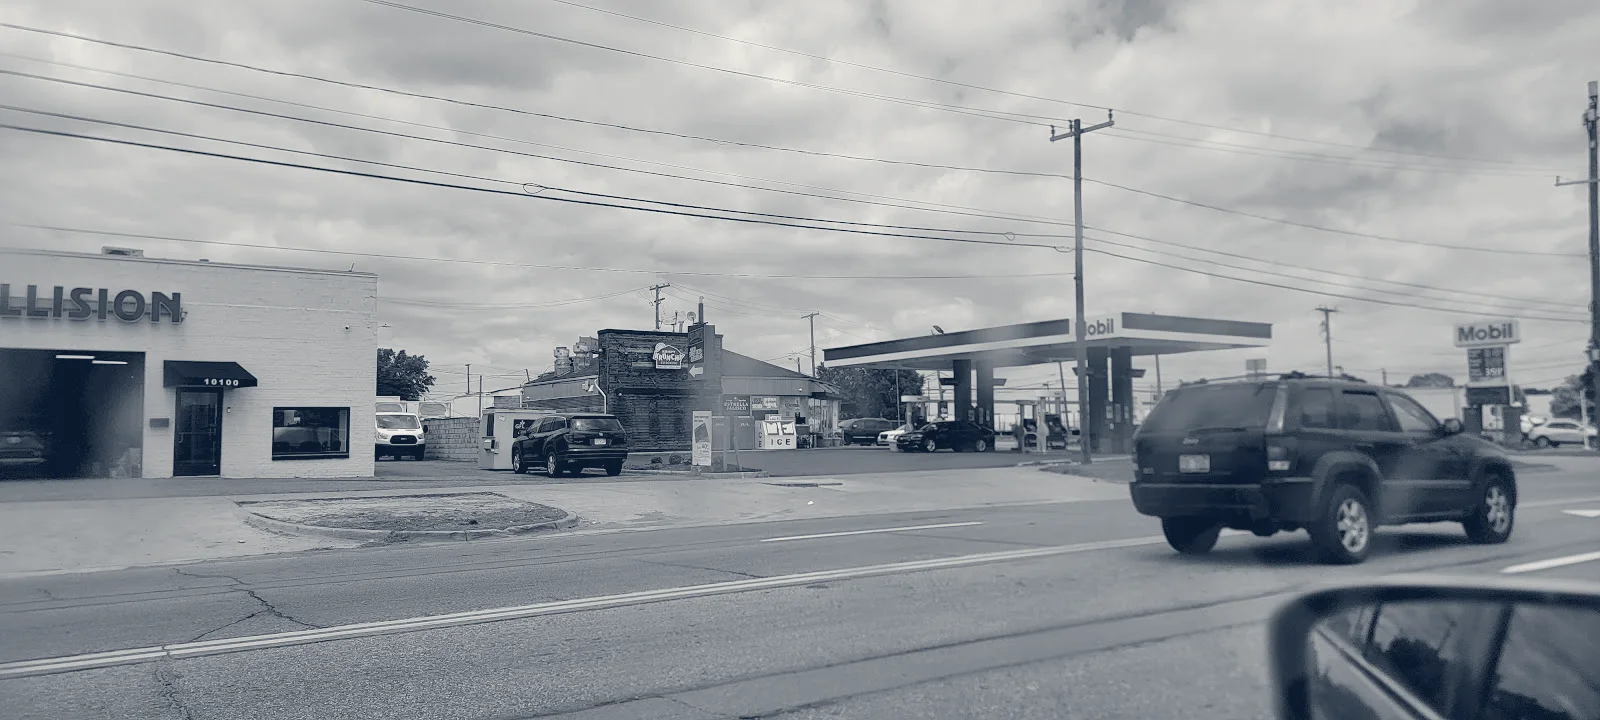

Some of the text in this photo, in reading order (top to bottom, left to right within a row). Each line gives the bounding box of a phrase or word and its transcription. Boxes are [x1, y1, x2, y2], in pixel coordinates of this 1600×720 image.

[0, 283, 182, 323] LLISION
[1084, 318, 1114, 336] obil
[1457, 323, 1513, 341] Mobil
[204, 378, 239, 386] 10100
[770, 438, 791, 446] ICE
